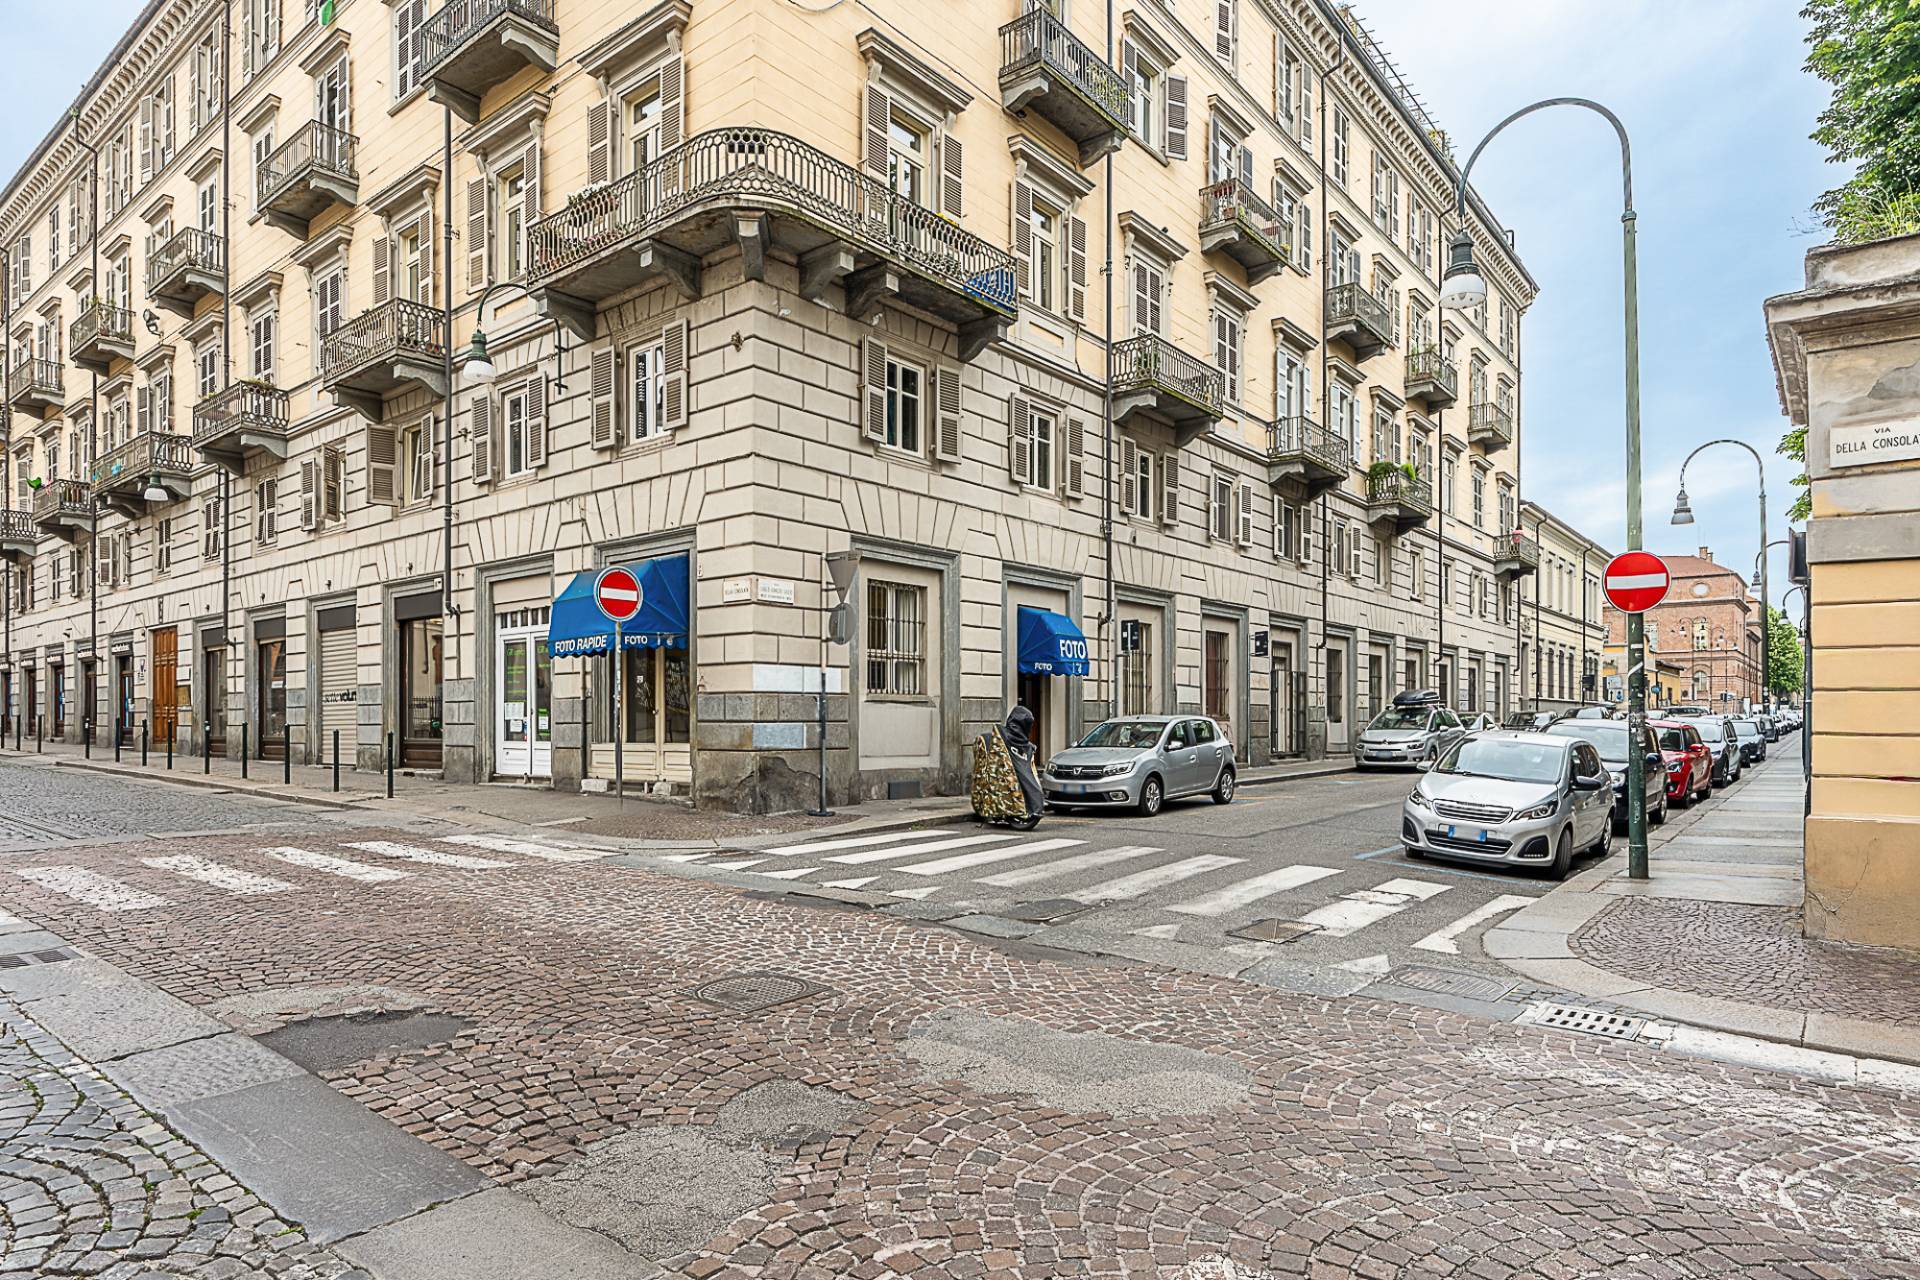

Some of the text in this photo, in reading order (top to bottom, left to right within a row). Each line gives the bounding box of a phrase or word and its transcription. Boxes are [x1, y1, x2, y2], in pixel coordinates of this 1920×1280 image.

[1836, 433, 1920, 454] DELLA CONSOLA
[555, 635, 608, 653] FOTO RAPIDE
[624, 635, 648, 645] FOTO
[1059, 639, 1086, 660] FOTO
[1034, 663, 1053, 671] FOTO
